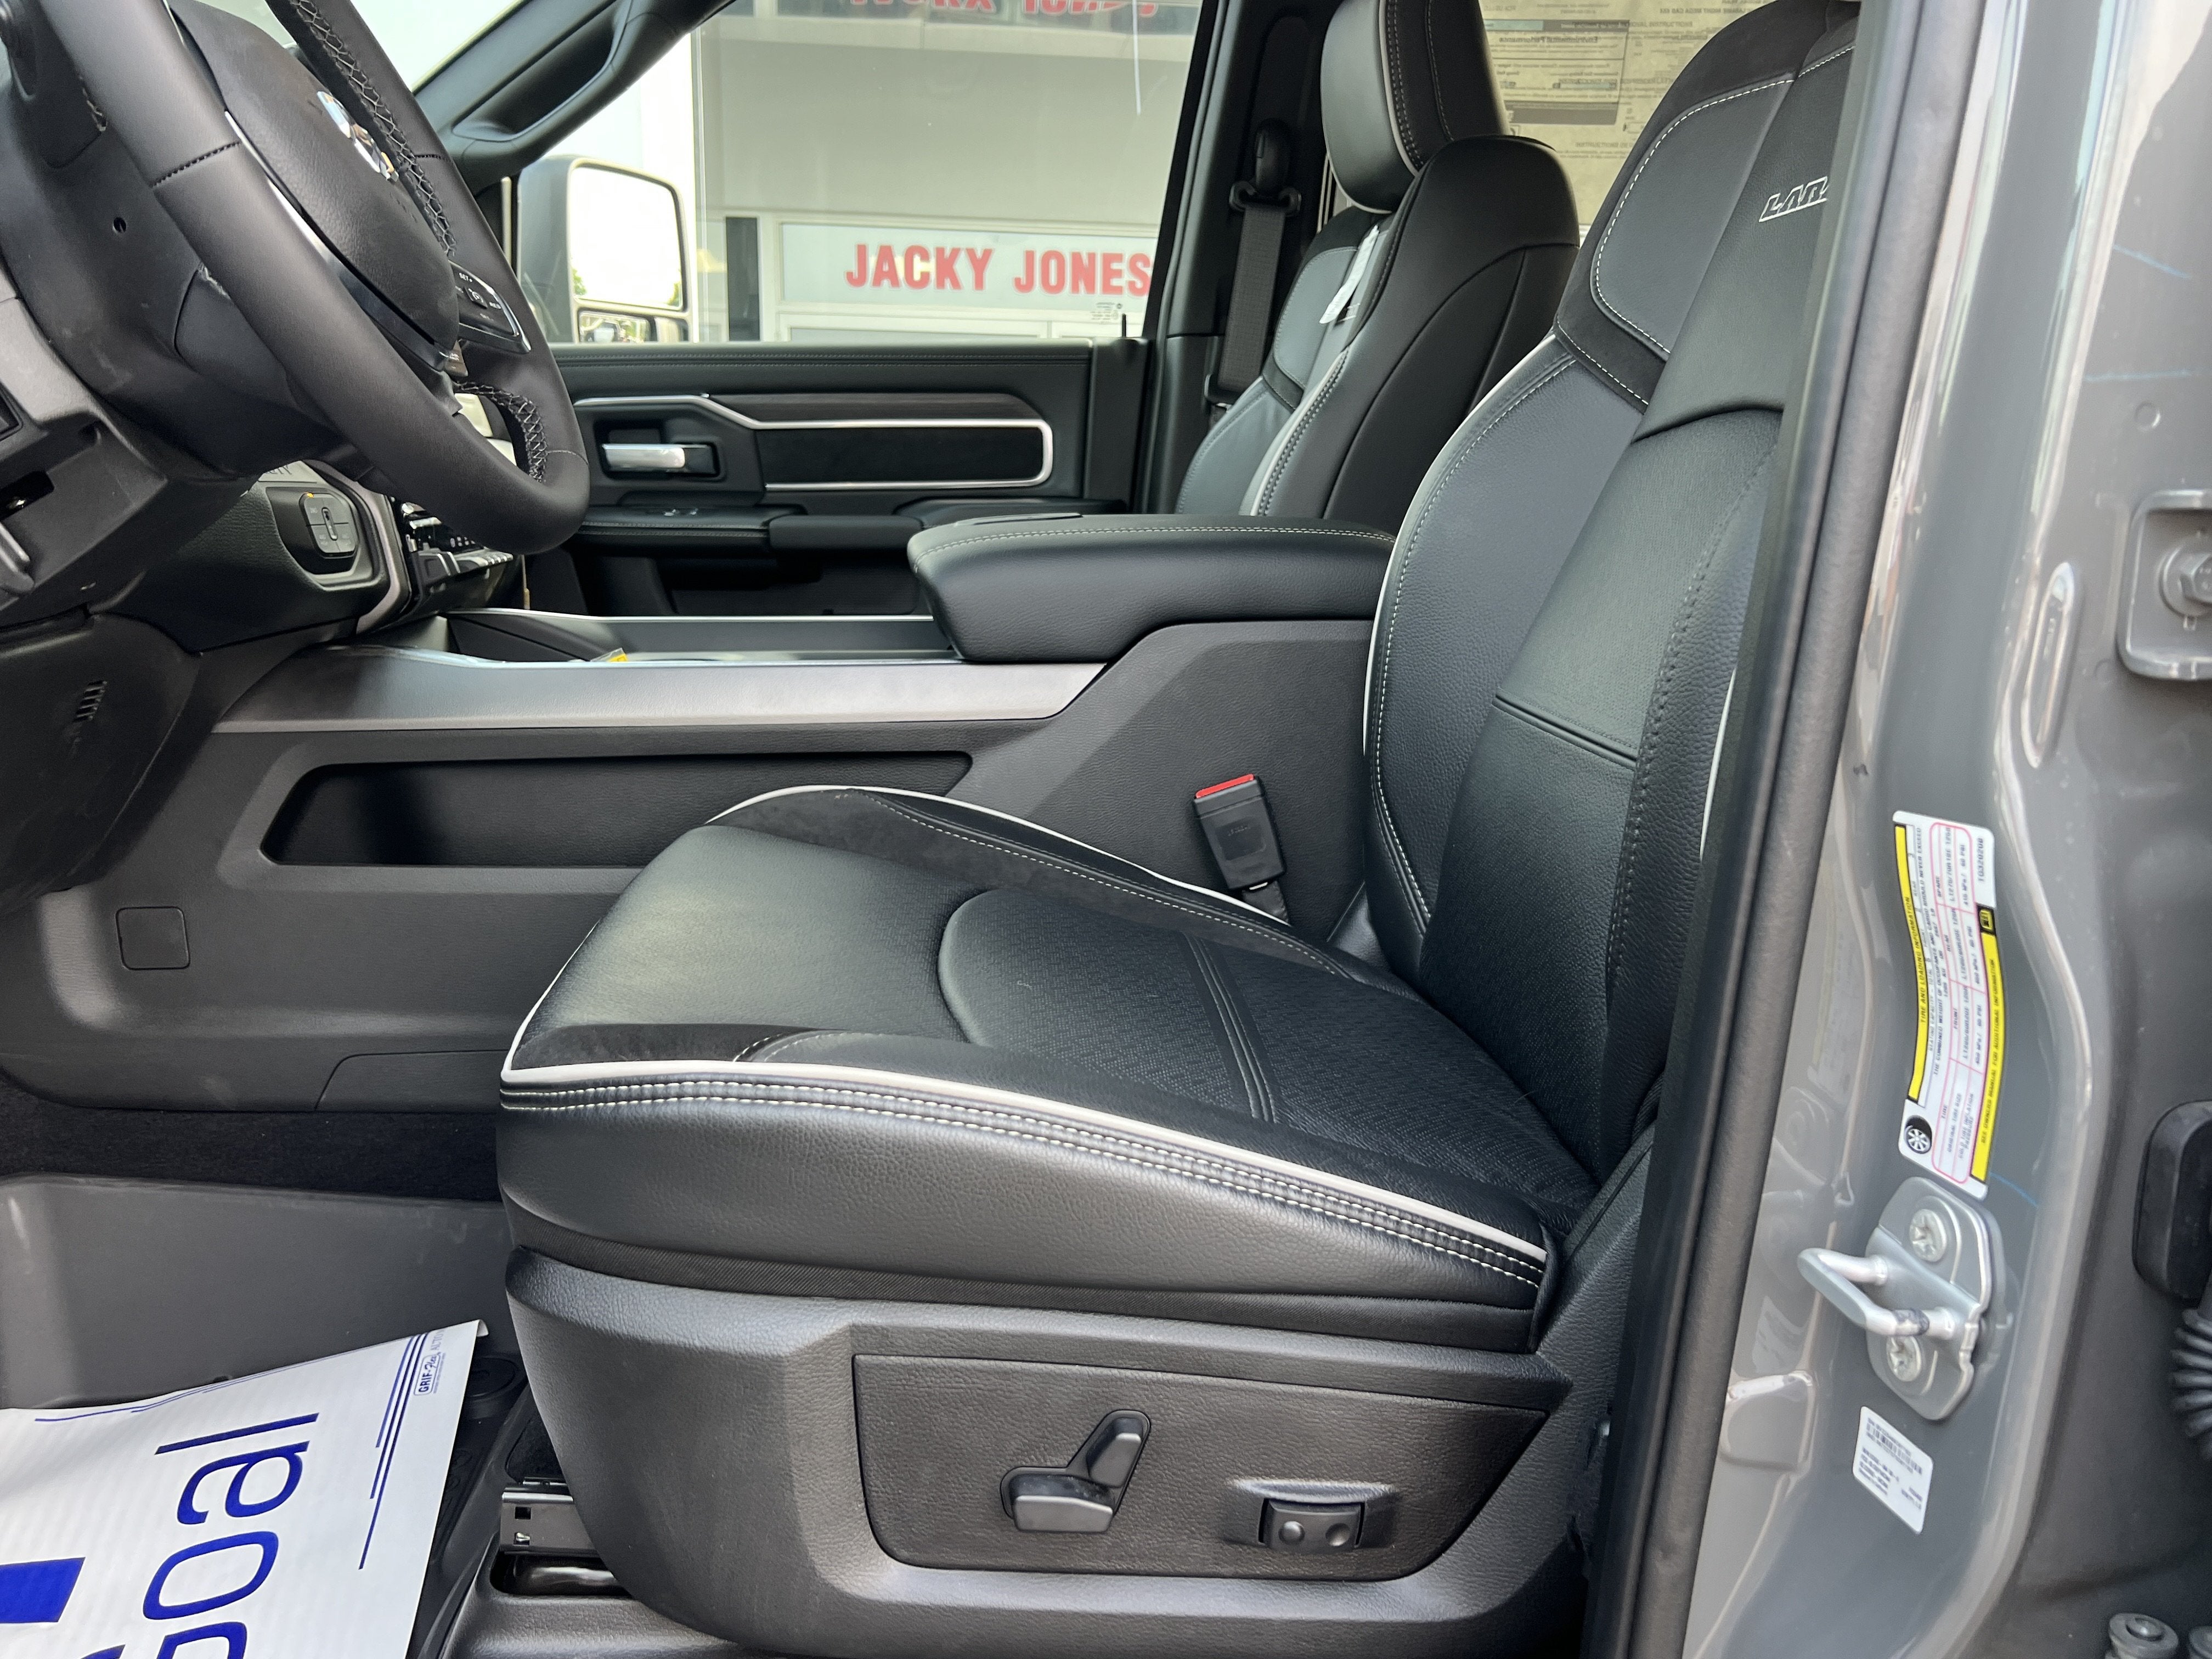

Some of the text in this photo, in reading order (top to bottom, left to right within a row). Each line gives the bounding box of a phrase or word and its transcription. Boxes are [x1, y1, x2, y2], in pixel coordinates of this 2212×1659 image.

[845, 243, 1152, 297] JACKY JONES
[1905, 896, 1918, 949] INFORMATION
[1916, 950, 1925, 985] LOADING
